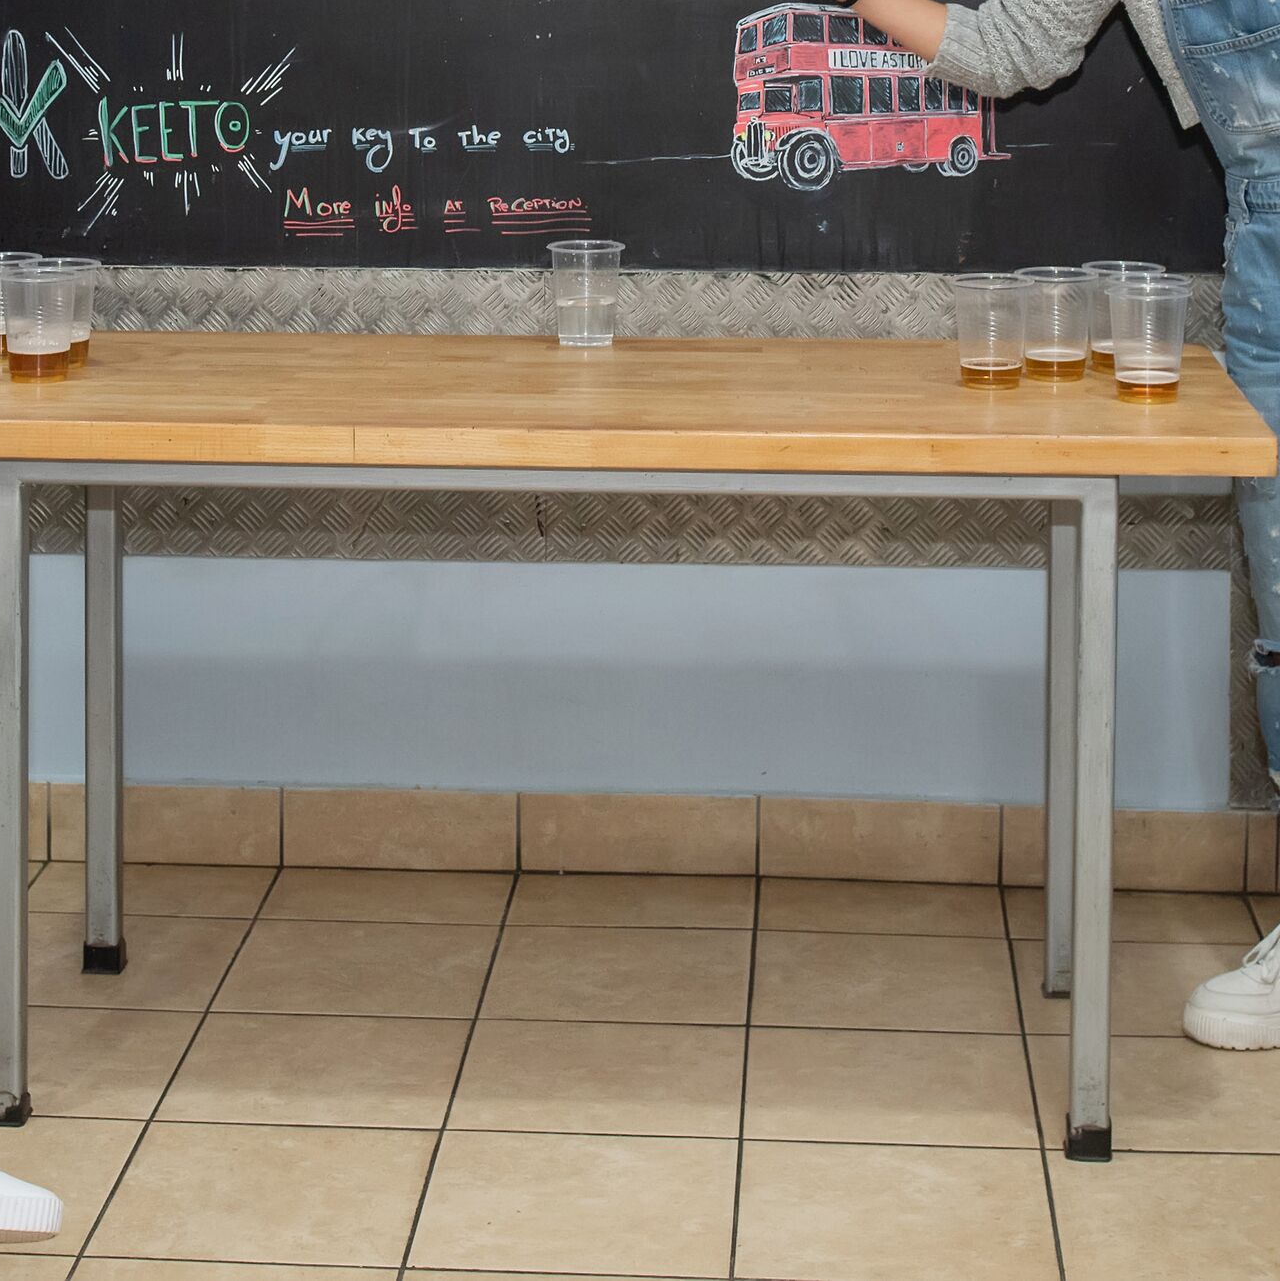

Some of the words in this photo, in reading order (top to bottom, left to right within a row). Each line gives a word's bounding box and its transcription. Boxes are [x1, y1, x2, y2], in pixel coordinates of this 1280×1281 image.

[841, 51, 877, 68] LOVE
[98, 96, 250, 167] KEETO
[270, 128, 332, 171] your
[284, 188, 351, 217] More
